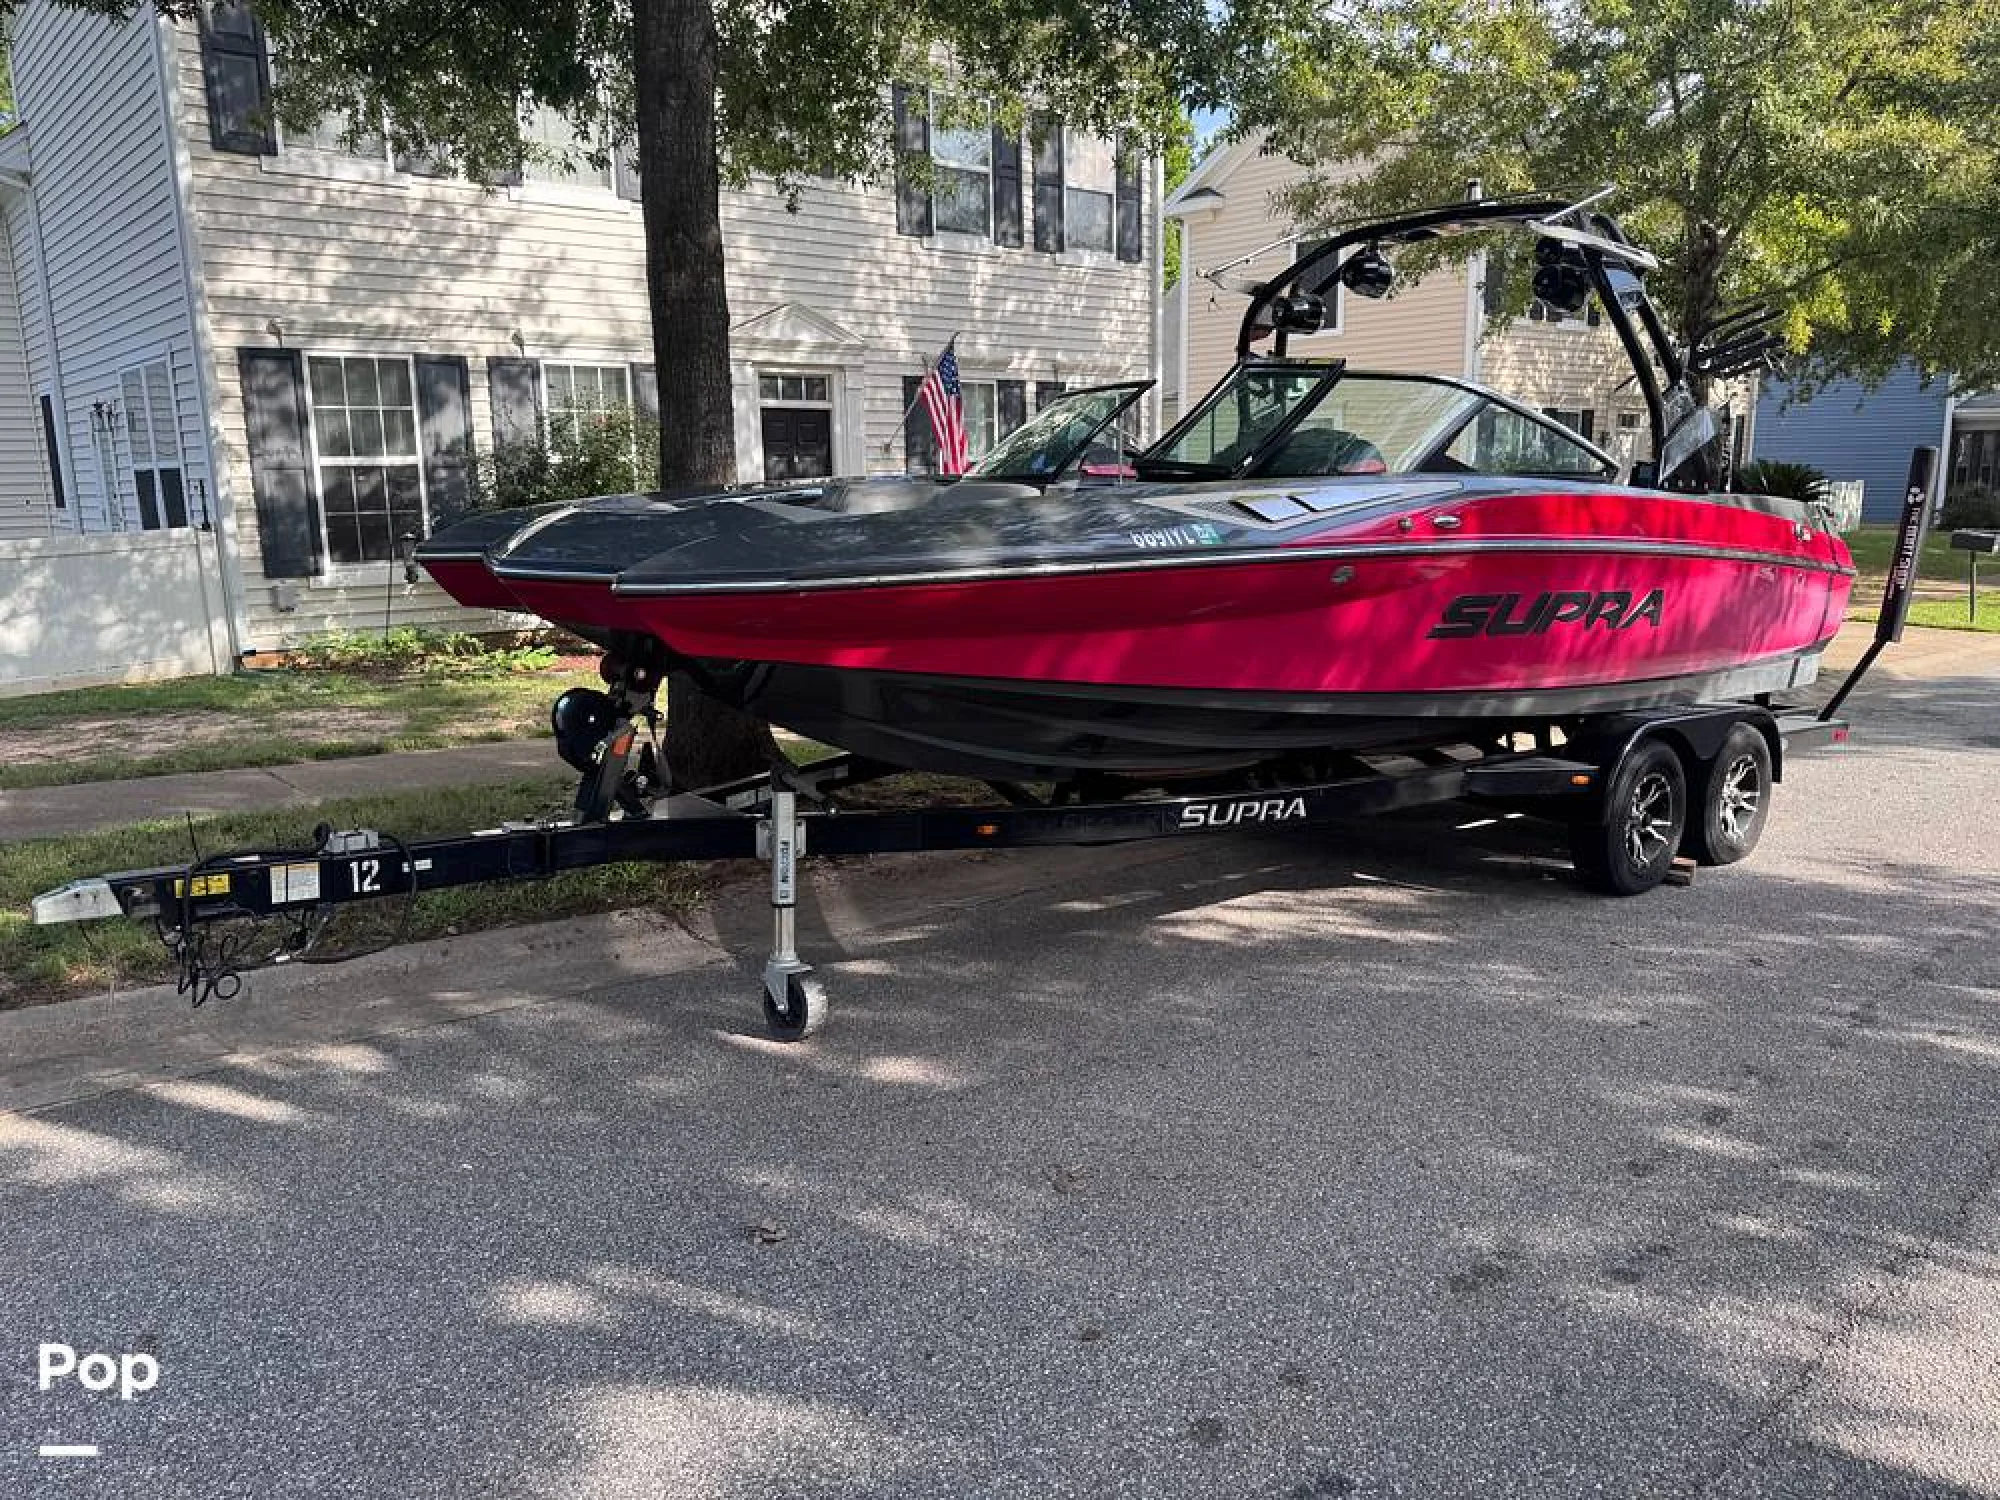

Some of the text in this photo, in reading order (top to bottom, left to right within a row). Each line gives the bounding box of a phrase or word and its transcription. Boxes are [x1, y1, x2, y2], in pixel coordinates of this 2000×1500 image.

[1426, 589, 1664, 640] SUPRA
[1179, 797, 1306, 828] SUPRA
[349, 859, 381, 893] 12
